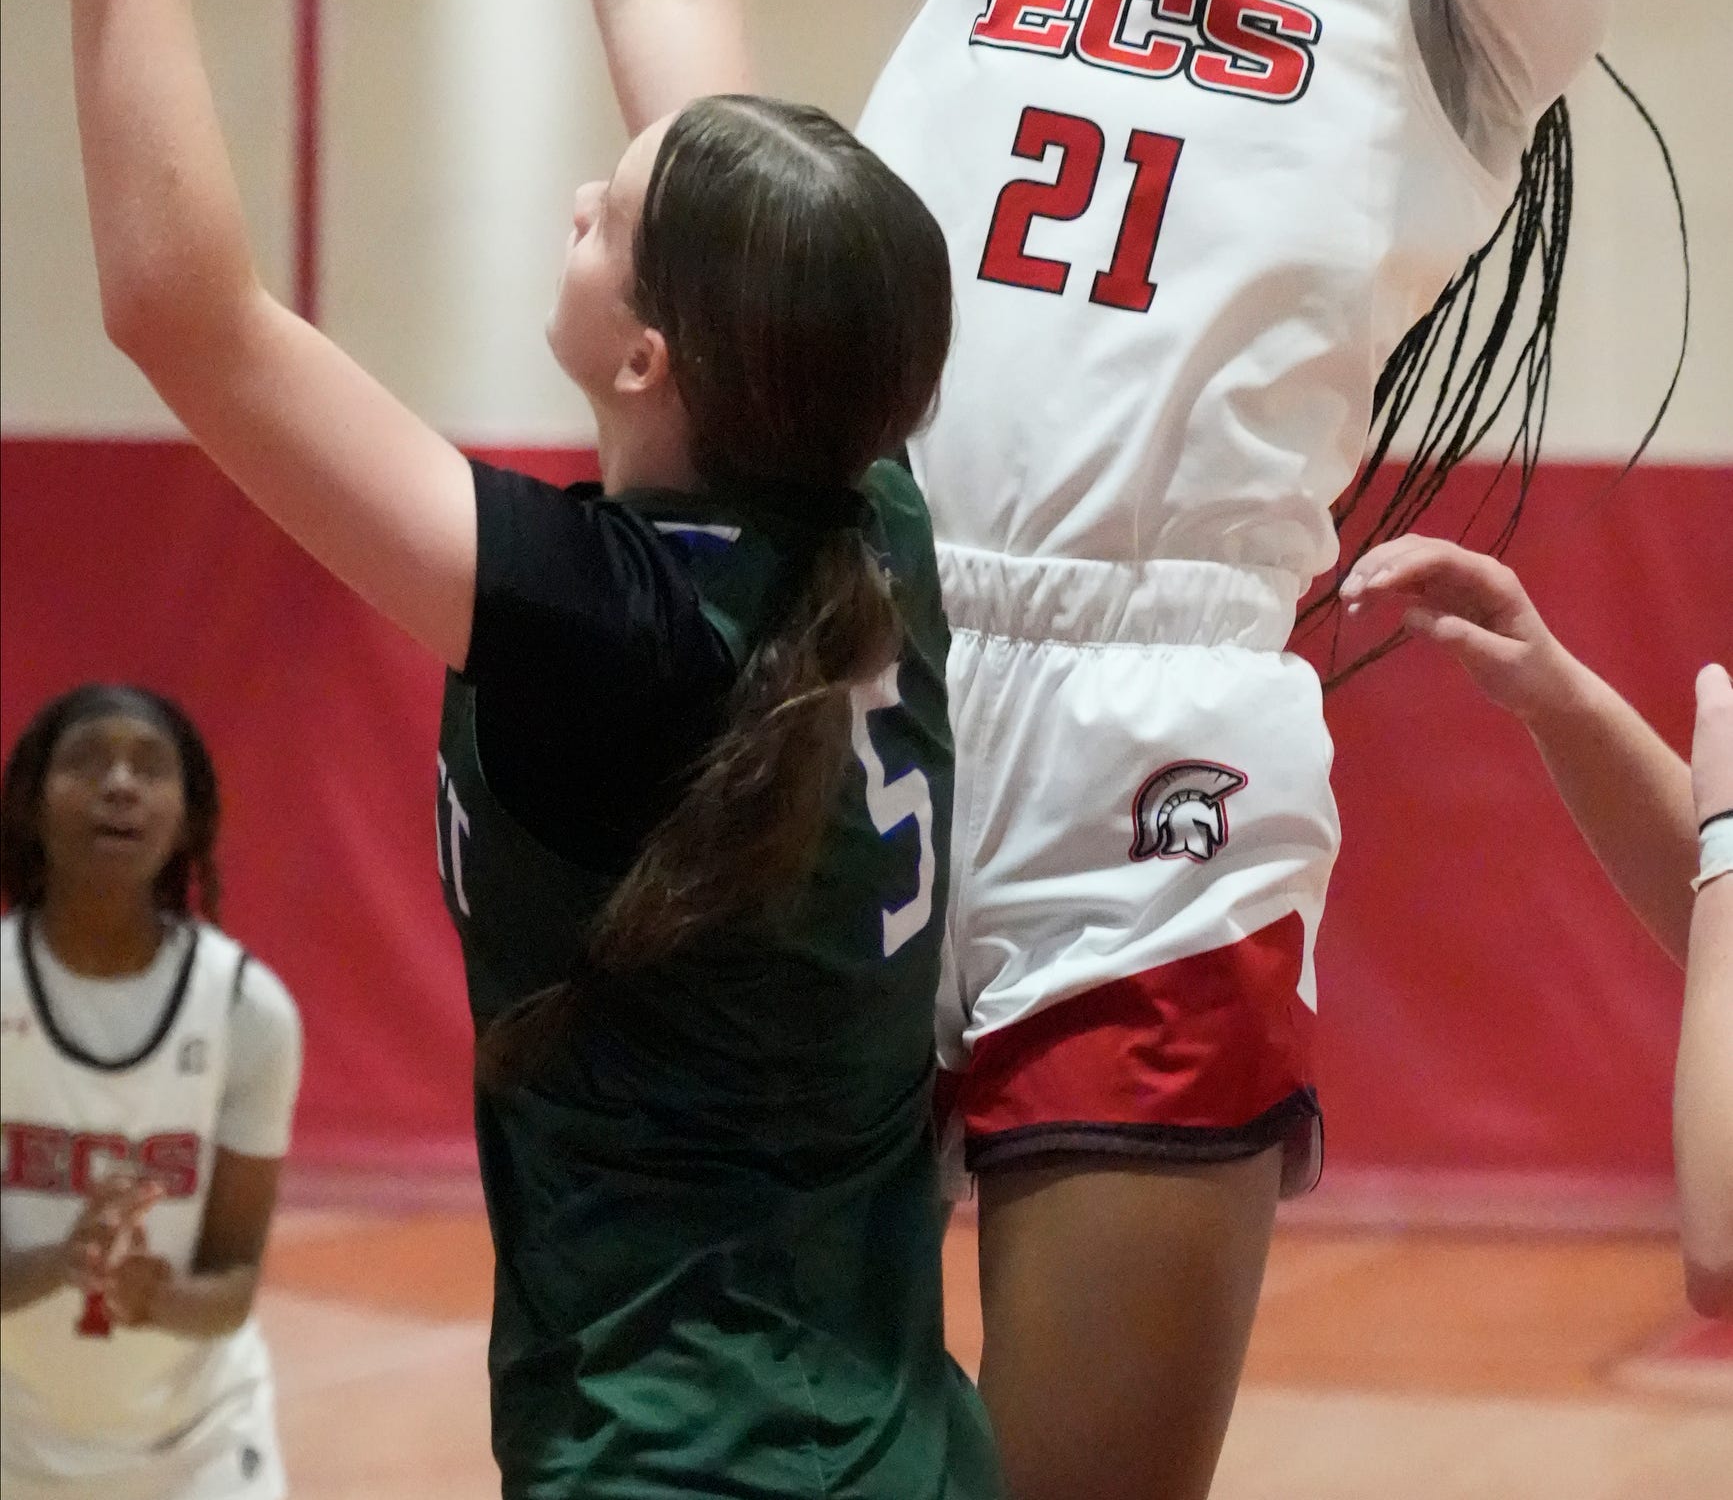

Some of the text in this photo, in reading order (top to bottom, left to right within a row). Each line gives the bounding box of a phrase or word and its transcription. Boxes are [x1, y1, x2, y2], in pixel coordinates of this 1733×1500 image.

[977, 105, 1186, 313] 21
[850, 660, 937, 960] 5
[2, 1117, 201, 1199] ECS
